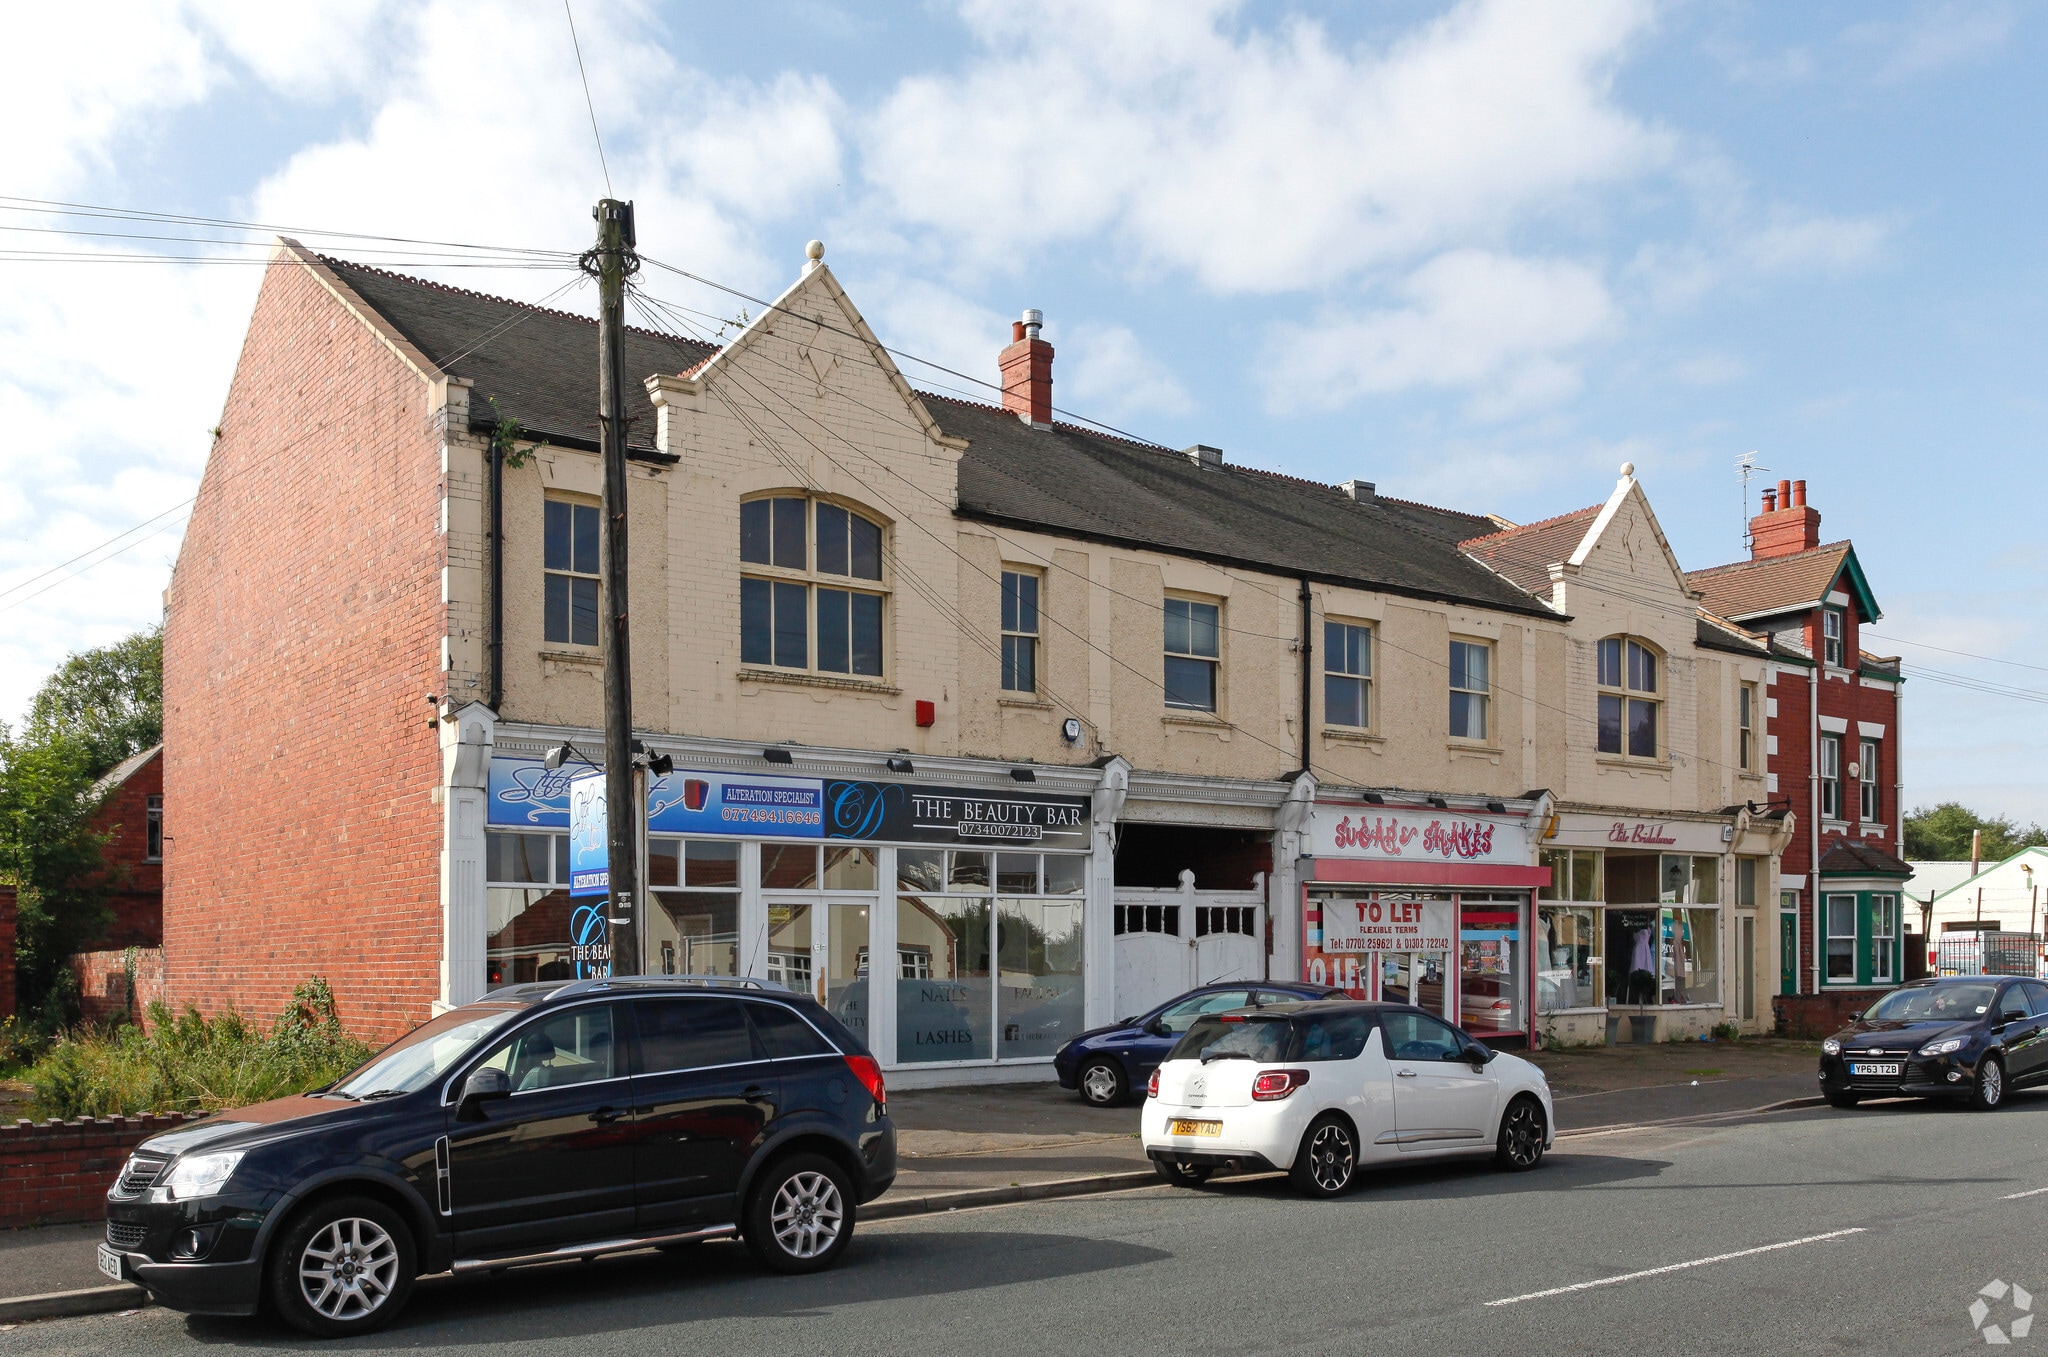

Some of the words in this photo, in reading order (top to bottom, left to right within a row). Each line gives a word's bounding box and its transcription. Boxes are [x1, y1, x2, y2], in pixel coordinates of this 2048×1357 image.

[726, 787, 772, 804] ALTERATION
[774, 790, 815, 806] SPECIALIST
[722, 807, 821, 824] 07749416646
[912, 799, 952, 819] THE
[963, 802, 1037, 825] BEAUTY
[1047, 807, 1083, 826] BAR
[960, 823, 1039, 838] 07340072123
[1335, 815, 1402, 856] SUGAR
[1423, 820, 1495, 859] SHAKES
[1608, 822, 1630, 842] Elite
[1631, 824, 1677, 845] Bridalwear
[1356, 902, 1382, 922] TO
[1390, 903, 1423, 923] LET
[1360, 926, 1392, 934] FLEXIBLE
[1395, 926, 1418, 934] TERMS
[1330, 938, 1343, 949] Tel:
[1346, 938, 1366, 949] 07702
[1367, 938, 1393, 949] 259621
[1396, 940, 1402, 949] &
[1405, 938, 1424, 949] 01302
[1426, 938, 1449, 949] 722142
[571, 945, 590, 961] THE
[1307, 958, 1327, 985] O
[921, 988, 967, 1002] NAILS
[845, 1000, 859, 1011] HE
[916, 1028, 972, 1045] LASHES
[1855, 1065, 1878, 1074] YP63
[1880, 1065, 1897, 1074] TZB
[1176, 1121, 1198, 1133] YS62
